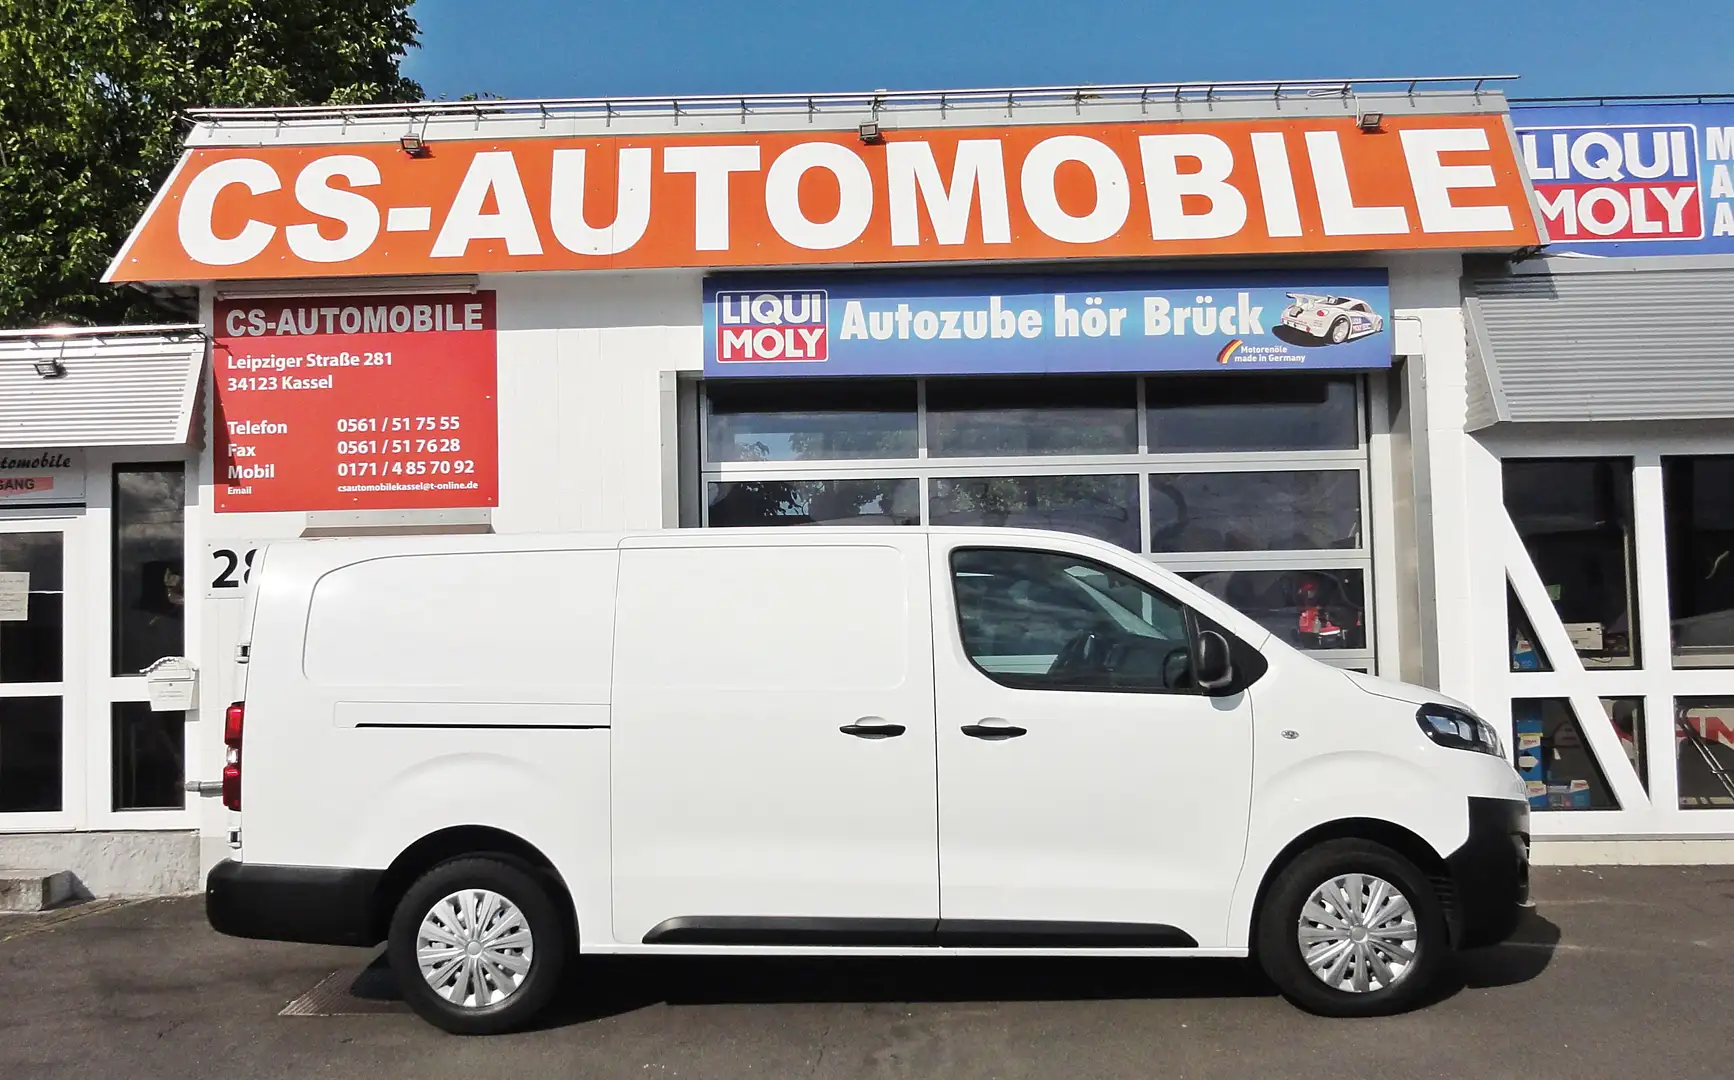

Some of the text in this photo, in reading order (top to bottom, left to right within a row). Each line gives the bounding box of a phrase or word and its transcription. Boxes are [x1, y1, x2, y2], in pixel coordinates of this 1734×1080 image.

[1522, 131, 1689, 182] LIQUI
[178, 127, 1514, 266] CS-AUTOMOBILE
[1534, 187, 1697, 236] MOLY
[722, 294, 822, 325] LIQUI
[839, 292, 1265, 340] Autozube hör Brück
[226, 303, 483, 337] CS-AUTOMOBILE
[723, 327, 826, 359] MOLY
[1240, 344, 1288, 354] Motorenöle
[227, 352, 393, 372] Leipziger Straße 281
[1234, 354, 1306, 363] made in Germany
[227, 374, 333, 391] 34123 Kassel
[227, 420, 288, 435] Telefon
[336, 416, 460, 432] 0561 / 51 75 55
[227, 443, 257, 458] Fax
[337, 438, 461, 454] 0561 / 51 76 28
[227, 464, 275, 479] Mobil
[337, 459, 475, 477] 0171 / 4 85 70 92
[227, 486, 252, 495] Email
[337, 481, 479, 492] csautomobilekassel@t-online.de
